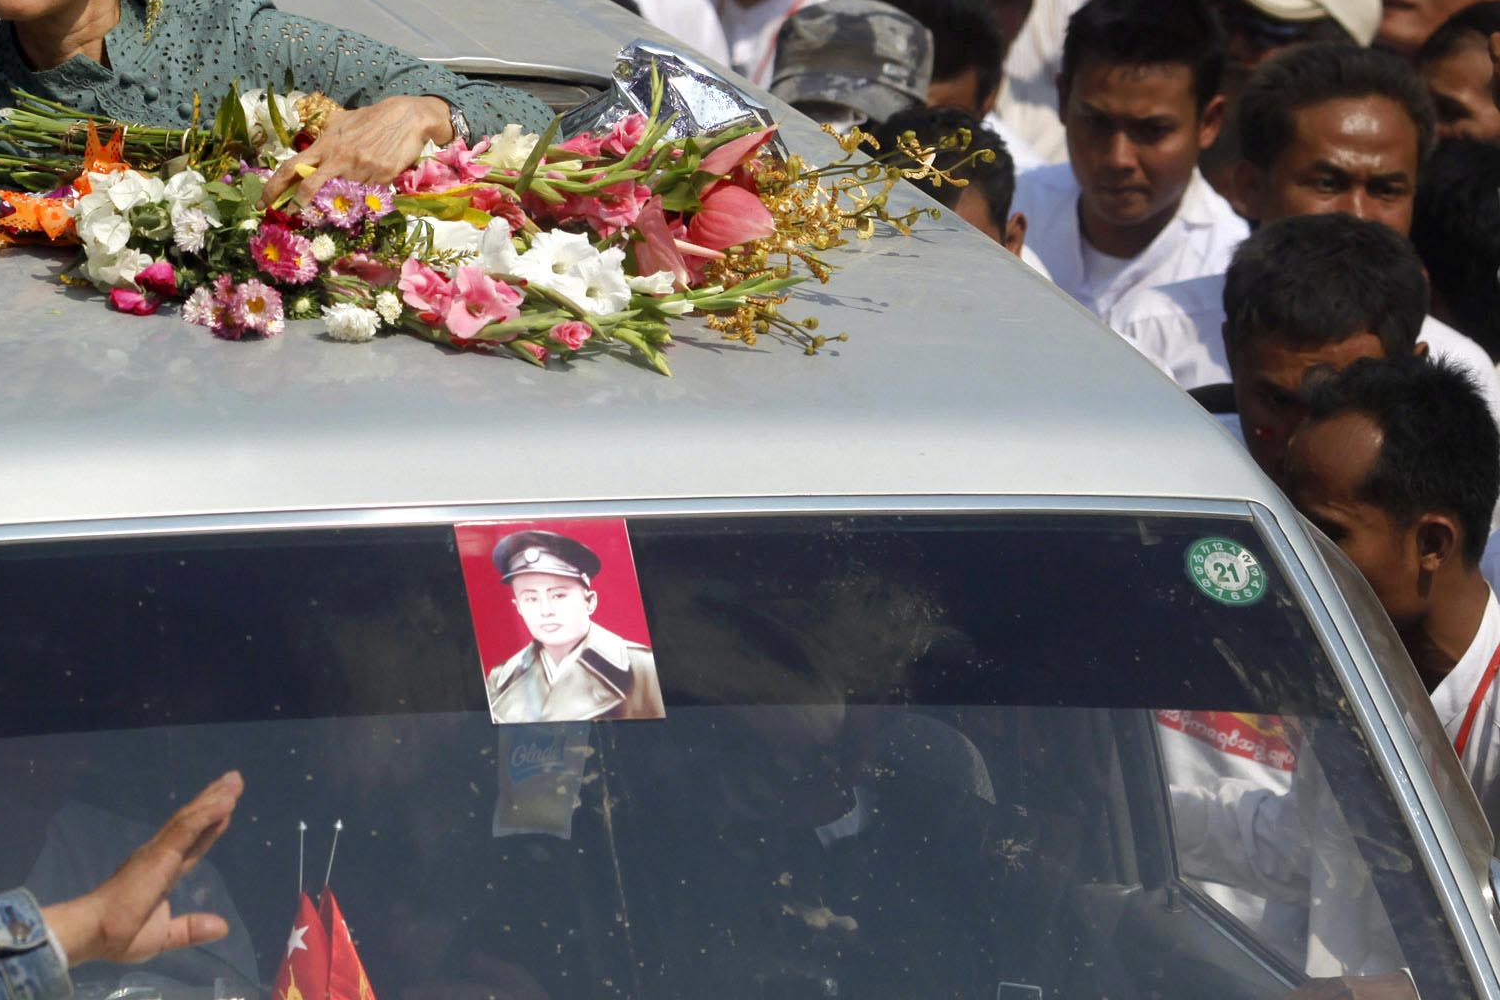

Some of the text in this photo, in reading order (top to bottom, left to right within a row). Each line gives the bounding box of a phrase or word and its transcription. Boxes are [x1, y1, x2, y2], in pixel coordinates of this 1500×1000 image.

[1200, 545, 1211, 554] 11
[1212, 542, 1225, 551] 12
[1229, 546, 1237, 554] 1
[1192, 554, 1204, 563] 10
[1242, 554, 1252, 563] 2
[1194, 566, 1204, 575] 9
[1213, 562, 1240, 583] 21
[1250, 567, 1260, 576] 3
[1201, 578, 1212, 588] 8
[1250, 580, 1260, 589] 4
[1215, 588, 1224, 597] 7
[1231, 591, 1240, 600] 6
[1243, 589, 1253, 598] 5
